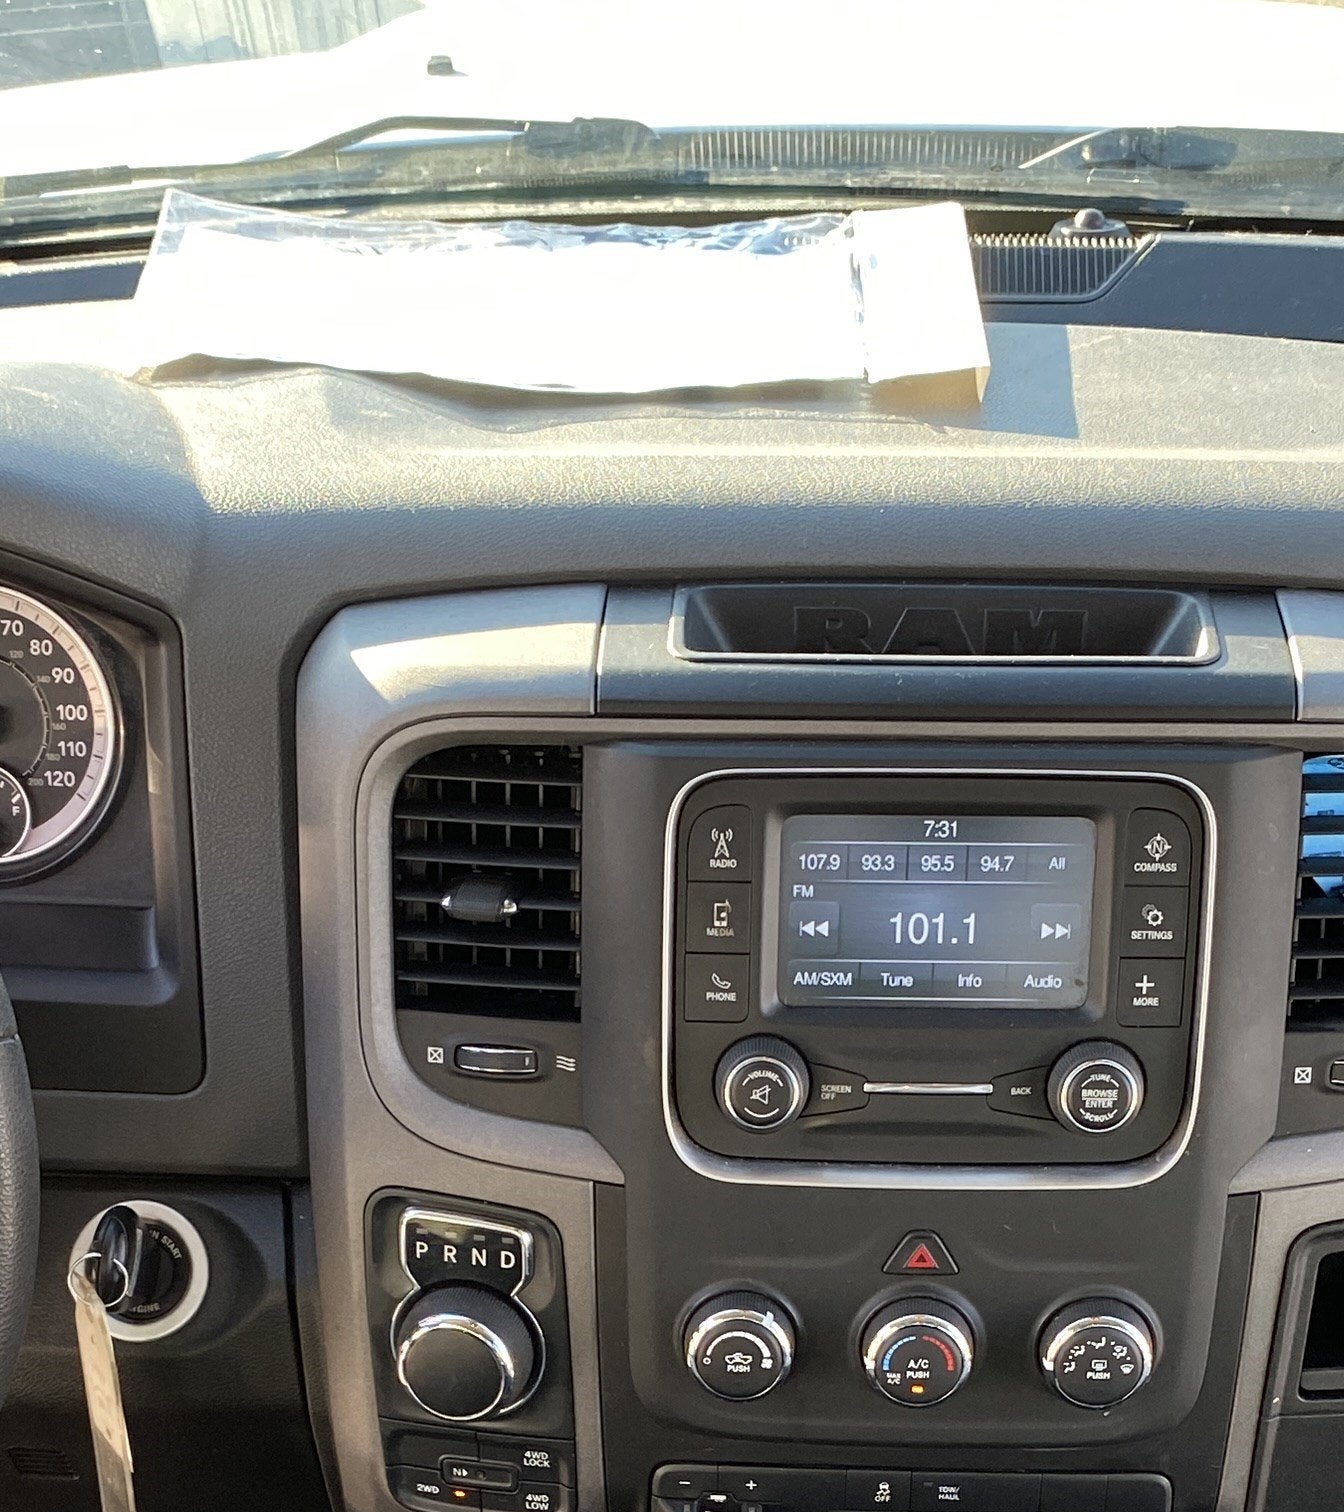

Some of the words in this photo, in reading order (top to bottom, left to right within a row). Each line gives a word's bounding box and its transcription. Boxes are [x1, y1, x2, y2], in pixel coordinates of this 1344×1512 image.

[0, 619, 24, 636] 70
[793, 606, 1088, 655] RAM
[29, 639, 53, 656] 80
[9, 650, 24, 659] 120
[51, 667, 75, 684] 90
[55, 704, 88, 722] 100
[52, 723, 67, 731] 160
[57, 741, 88, 757] 110
[27, 778, 44, 786] 200
[43, 770, 76, 788] 120
[12, 806, 20, 816] F
[923, 820, 958, 838] 7:31
[709, 858, 737, 869] RADIO
[798, 854, 841, 871] 107.9
[861, 854, 895, 871] 93.3
[920, 855, 955, 872] 95.5
[979, 856, 1015, 872] 94.7
[1048, 858, 1066, 870] All
[1133, 862, 1177, 873] COMPASS
[792, 884, 814, 898] FM
[706, 927, 735, 937] MEDIA
[889, 912, 976, 945] 101.1
[1131, 930, 1173, 941] SETTINGS
[793, 971, 853, 986] AM/SXM
[880, 973, 914, 987] Tune
[957, 974, 983, 988] Info
[1023, 974, 1063, 989] Audio
[705, 992, 737, 1002] PHONE
[1132, 997, 1159, 1007] MORE
[747, 1070, 780, 1082] VOLUME
[1090, 1074, 1113, 1083] TUNE
[820, 1084, 852, 1093] SCREEN
[1010, 1086, 1032, 1096] BACK
[1081, 1088, 1119, 1098] BROWSE
[820, 1092, 836, 1101] OFF
[1084, 1099, 1114, 1109] ENTER
[1084, 1112, 1115, 1123] SCROLL
[160, 1235, 183, 1260] START
[416, 1241, 429, 1258] P
[444, 1245, 457, 1263] R
[471, 1249, 487, 1267] N
[500, 1251, 516, 1269] D
[726, 1365, 751, 1373] PUSH
[907, 1358, 929, 1369] A/C
[906, 1371, 930, 1379] PUSH
[1086, 1371, 1111, 1380] PUSH
[523, 1450, 549, 1460] 4WD
[523, 1458, 551, 1468] LOCK
[417, 1483, 440, 1494] 2WD
[525, 1493, 550, 1503] 4WD
[525, 1501, 550, 1511] LOW
